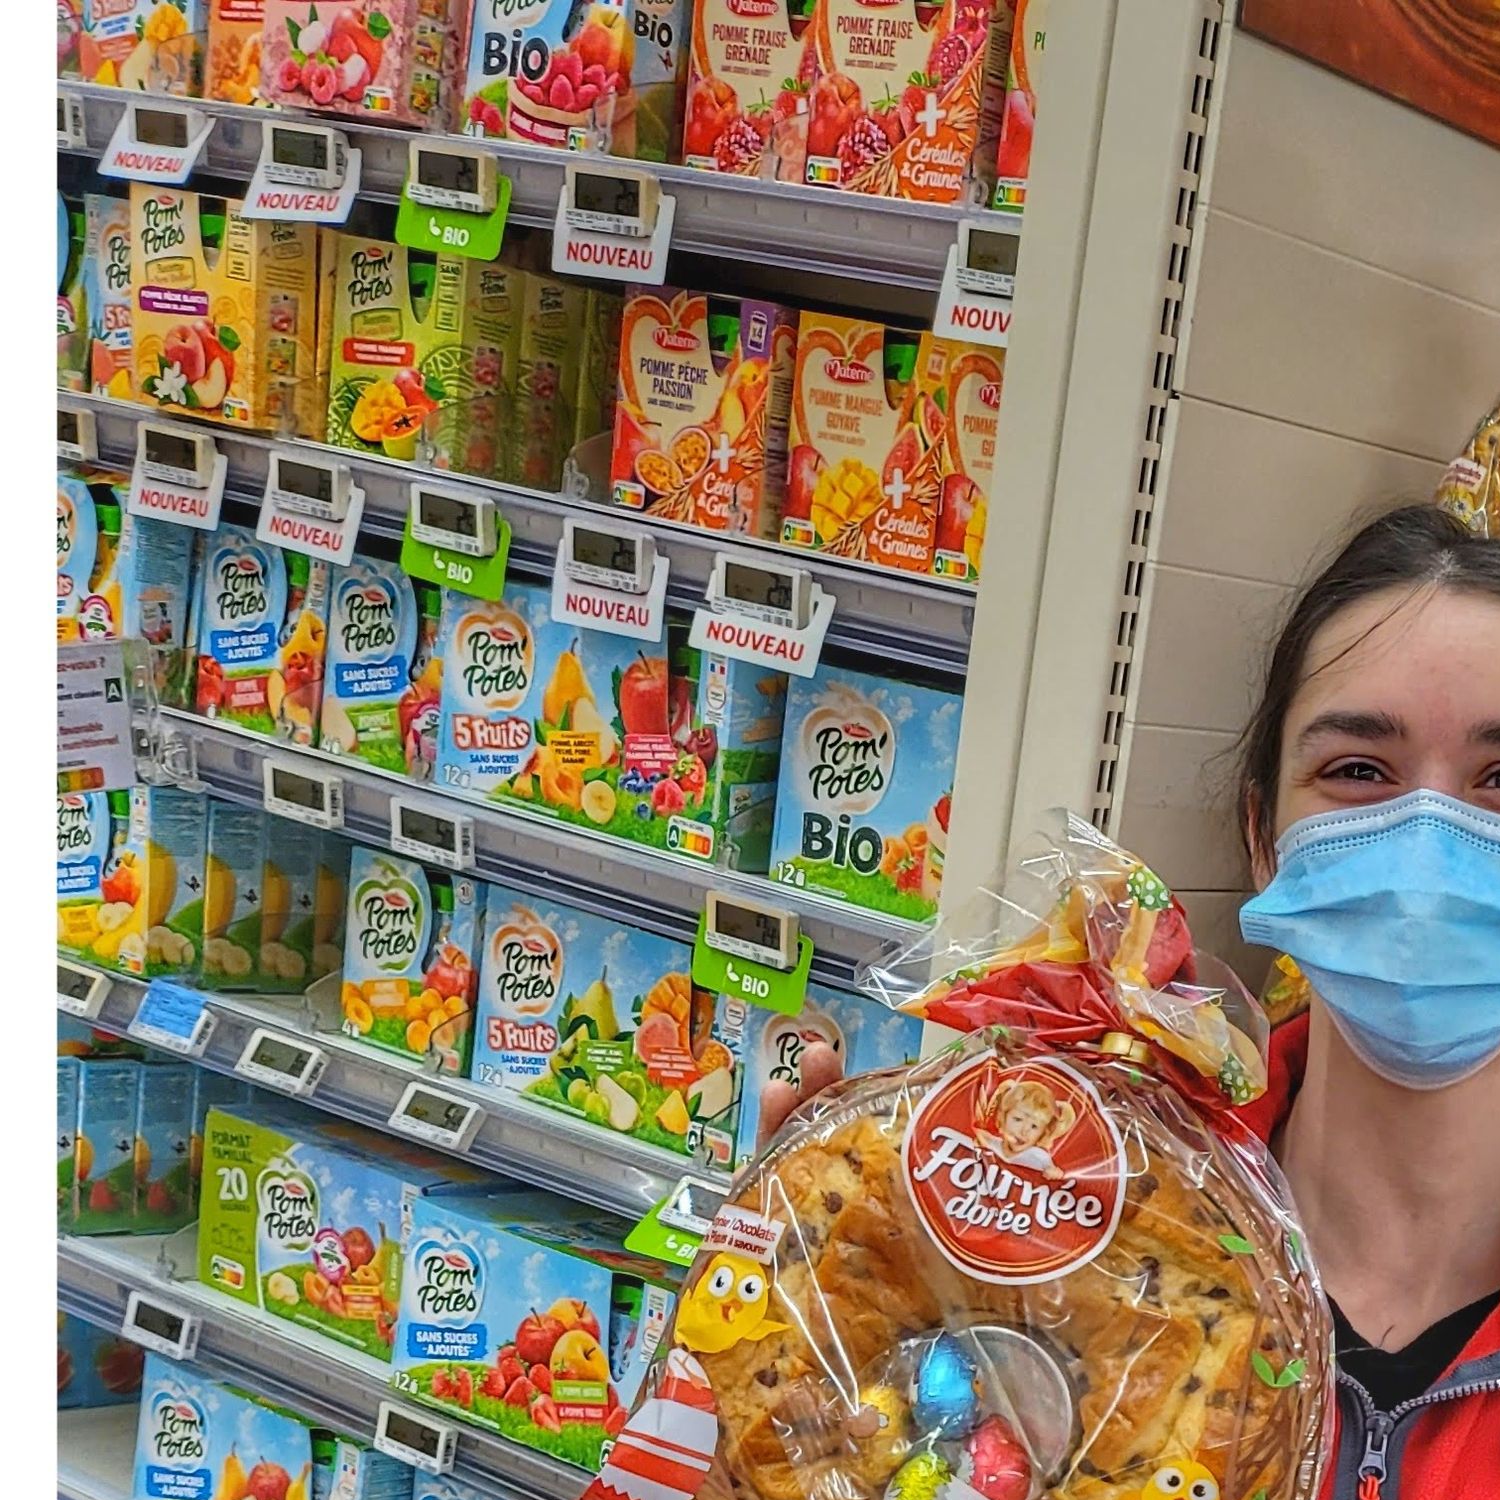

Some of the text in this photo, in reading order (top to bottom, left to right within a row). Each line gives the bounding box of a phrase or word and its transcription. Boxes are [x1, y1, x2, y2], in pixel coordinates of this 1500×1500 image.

[634, 10, 674, 49] Bio
[713, 24, 788, 49] POMME FRAISE
[837, 16, 914, 41] POMME FRAISE
[483, 30, 550, 86] Bio
[725, 44, 771, 66] GRENADE
[850, 36, 896, 58] GRENADE
[113, 151, 186, 174] NOUVEAU
[255, 192, 342, 213] NOUVEAU
[442, 225, 470, 247] BIO
[567, 241, 653, 270] NOUVEAU
[951, 305, 1013, 333] NOUV
[639, 357, 677, 379] POMME
[825, 359, 875, 384] Materne
[652, 377, 694, 399] PASSION
[139, 488, 209, 518] NOUVEAU
[270, 515, 343, 552] NOUVEAU
[445, 562, 474, 584] BIO
[565, 593, 650, 628] NOUVEAU
[706, 621, 805, 662] NOUVEAU
[463, 663, 529, 698] Potes
[453, 719, 532, 749] 5 Fruits
[442, 763, 461, 786] 12
[808, 762, 884, 800] Potes
[801, 812, 883, 875] Bio
[776, 861, 795, 884] 12
[359, 930, 417, 961] Potes
[497, 972, 556, 1004] Potes
[740, 976, 771, 999] BIO
[487, 1022, 558, 1051] 5 Fruits
[477, 1062, 495, 1085] 12
[216, 1167, 248, 1201] 20
[912, 1124, 1105, 1230] Fournée
[264, 1212, 317, 1242] Potes
[943, 1189, 1033, 1238] dorée
[676, 1243, 698, 1259] BI
[417, 1285, 477, 1315] Potes
[415, 1330, 479, 1345] SANS SUCRES
[394, 1370, 411, 1391] 12
